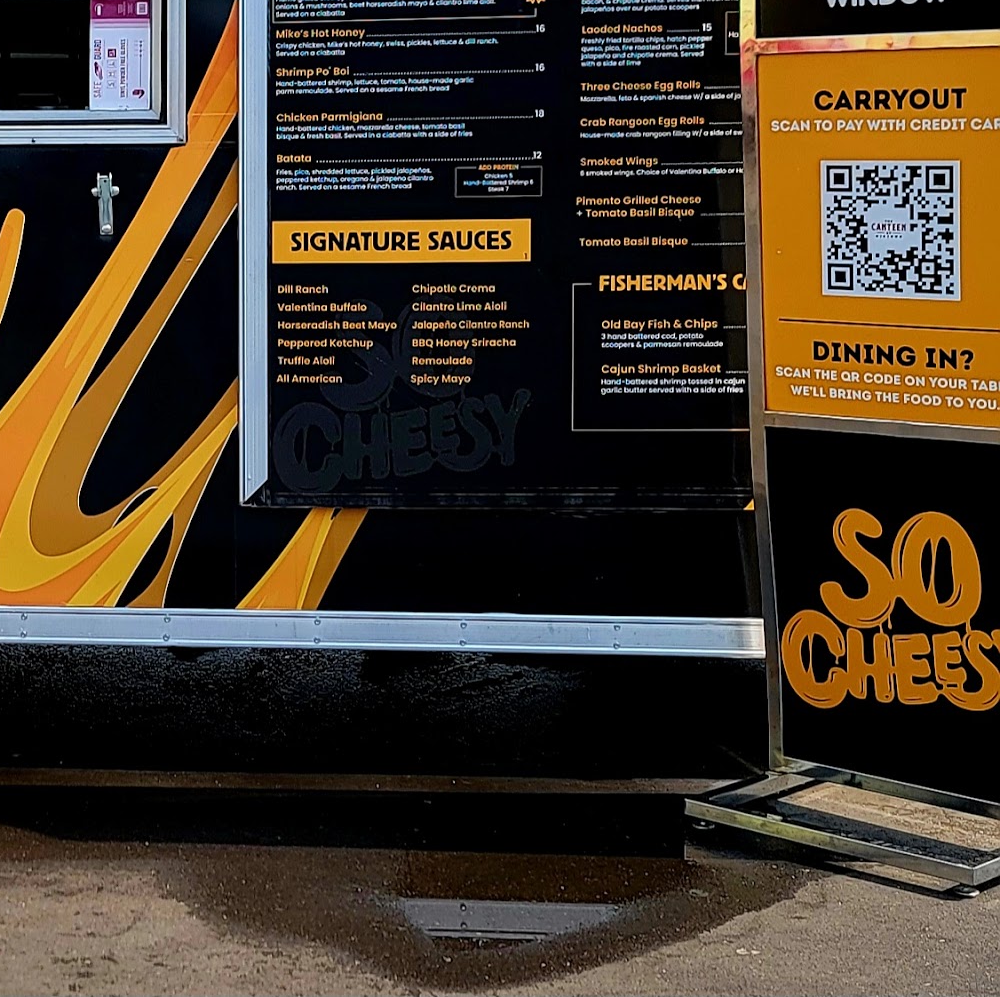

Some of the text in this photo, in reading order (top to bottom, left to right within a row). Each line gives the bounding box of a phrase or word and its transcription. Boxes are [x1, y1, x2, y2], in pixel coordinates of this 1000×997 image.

[276, 23, 545, 39] Mike's Hot Honey 16
[582, 22, 712, 34] Laoded Nachos 15
[276, 62, 545, 78] Shrimp Po' Boi 16
[581, 79, 701, 92] Three Cheese Egg Rolls
[814, 88, 967, 111] CARRYOUT
[276, 108, 544, 123] Chicken Parmigiana 18
[580, 115, 705, 128] Crab Rangoon Egg Rolls
[771, 120, 810, 131] SCAN
[814, 120, 833, 131] TO
[837, 119, 864, 131] PAY
[867, 119, 906, 131] WITH
[910, 118, 967, 131] CREDIT
[277, 150, 542, 163] Batata 12
[580, 156, 658, 168] Smoked Wings
[576, 194, 701, 206] Pimento Grilled Cheese
[871, 222, 907, 232] CANTEEN
[291, 230, 512, 252] SIGNATURE SAUCES
[277, 283, 328, 294] Dill Ranch
[599, 274, 727, 292] FISHERMAN'S
[277, 301, 367, 312] Valentina Buffalo
[278, 319, 397, 332] Horseradish Beet Mayo
[601, 318, 718, 331] Old Bay Fish & Chips
[278, 339, 373, 350] Peppered Ketchup
[278, 355, 335, 365] Truffle Aioli
[412, 355, 473, 365] Remoulade
[813, 341, 974, 370] DINING IN?
[601, 363, 721, 376] Cajun Shrimp Basket
[277, 373, 342, 383] All American
[776, 366, 1000, 391] SCAN THE QR CODE ON YOUR TAB
[791, 385, 1000, 410] WE'LL BRING THE FOOD TO YOU.
[820, 508, 982, 628] SO
[781, 610, 1000, 711] CHEES
